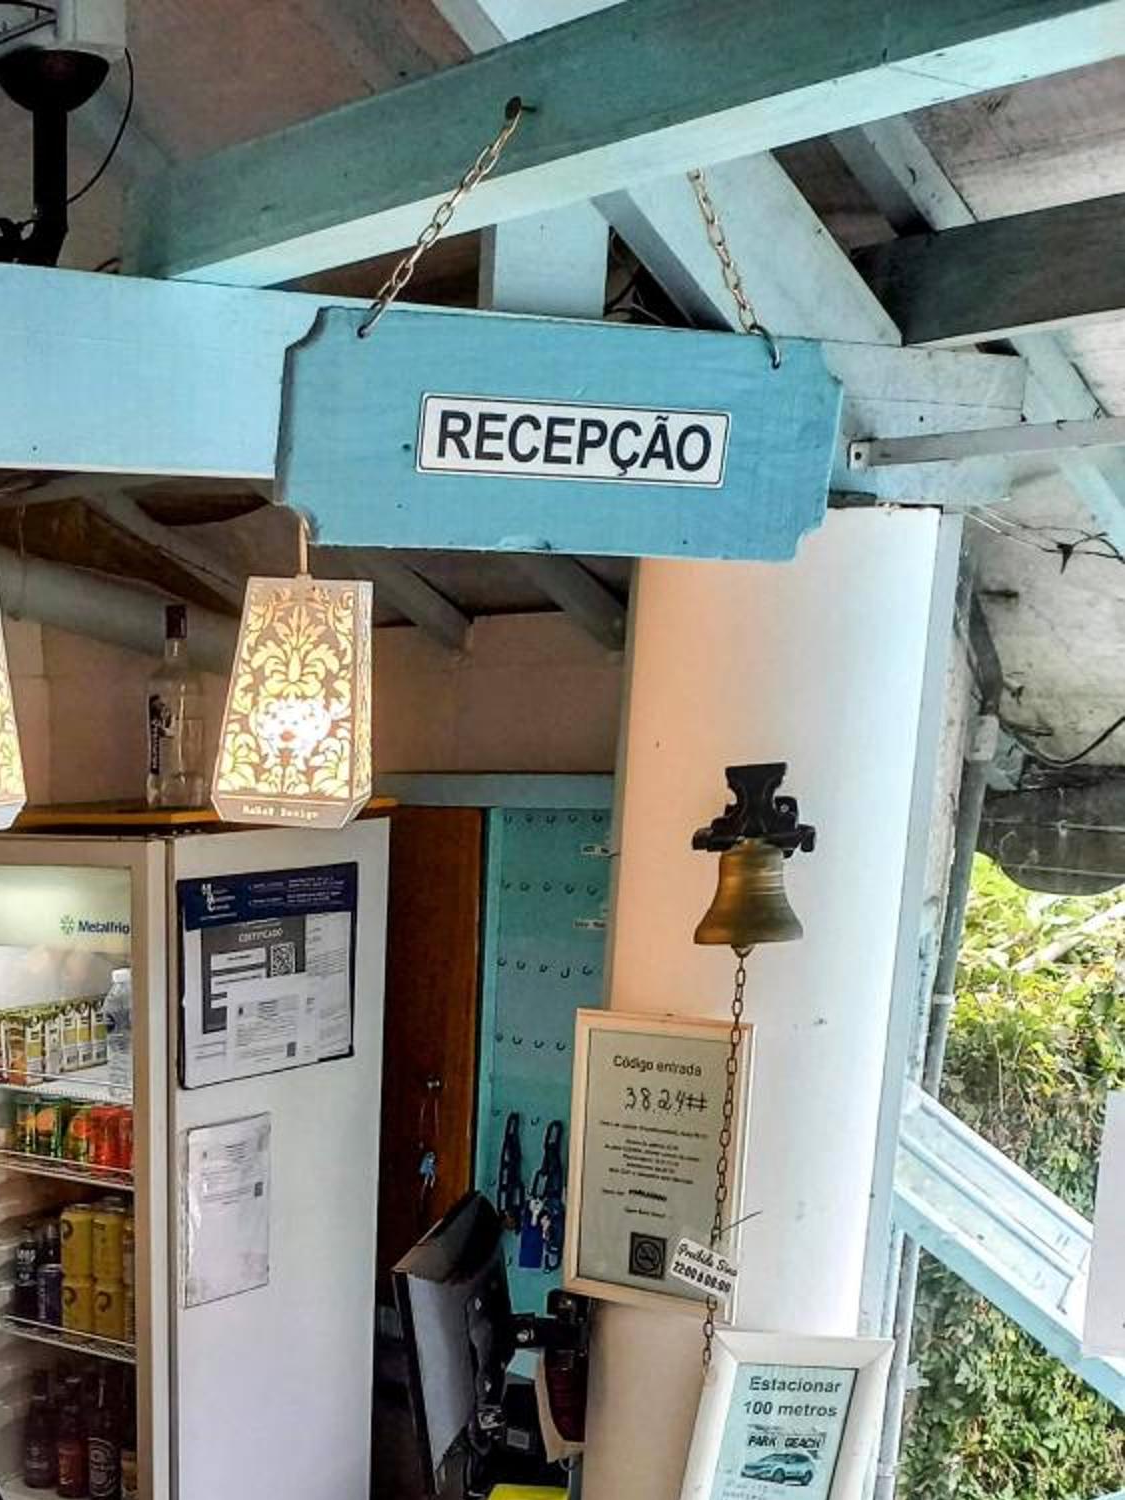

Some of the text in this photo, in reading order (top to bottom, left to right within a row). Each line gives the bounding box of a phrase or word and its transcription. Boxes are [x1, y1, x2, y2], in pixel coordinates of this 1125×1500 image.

[436, 409, 712, 477] RECEPÇÃO
[78, 920, 130, 935] Metalfrio
[613, 1055, 702, 1076] Código entrada
[749, 1375, 843, 1393] Estacionar
[744, 1401, 838, 1417] 100 metros
[748, 1435, 777, 1447] PARK
